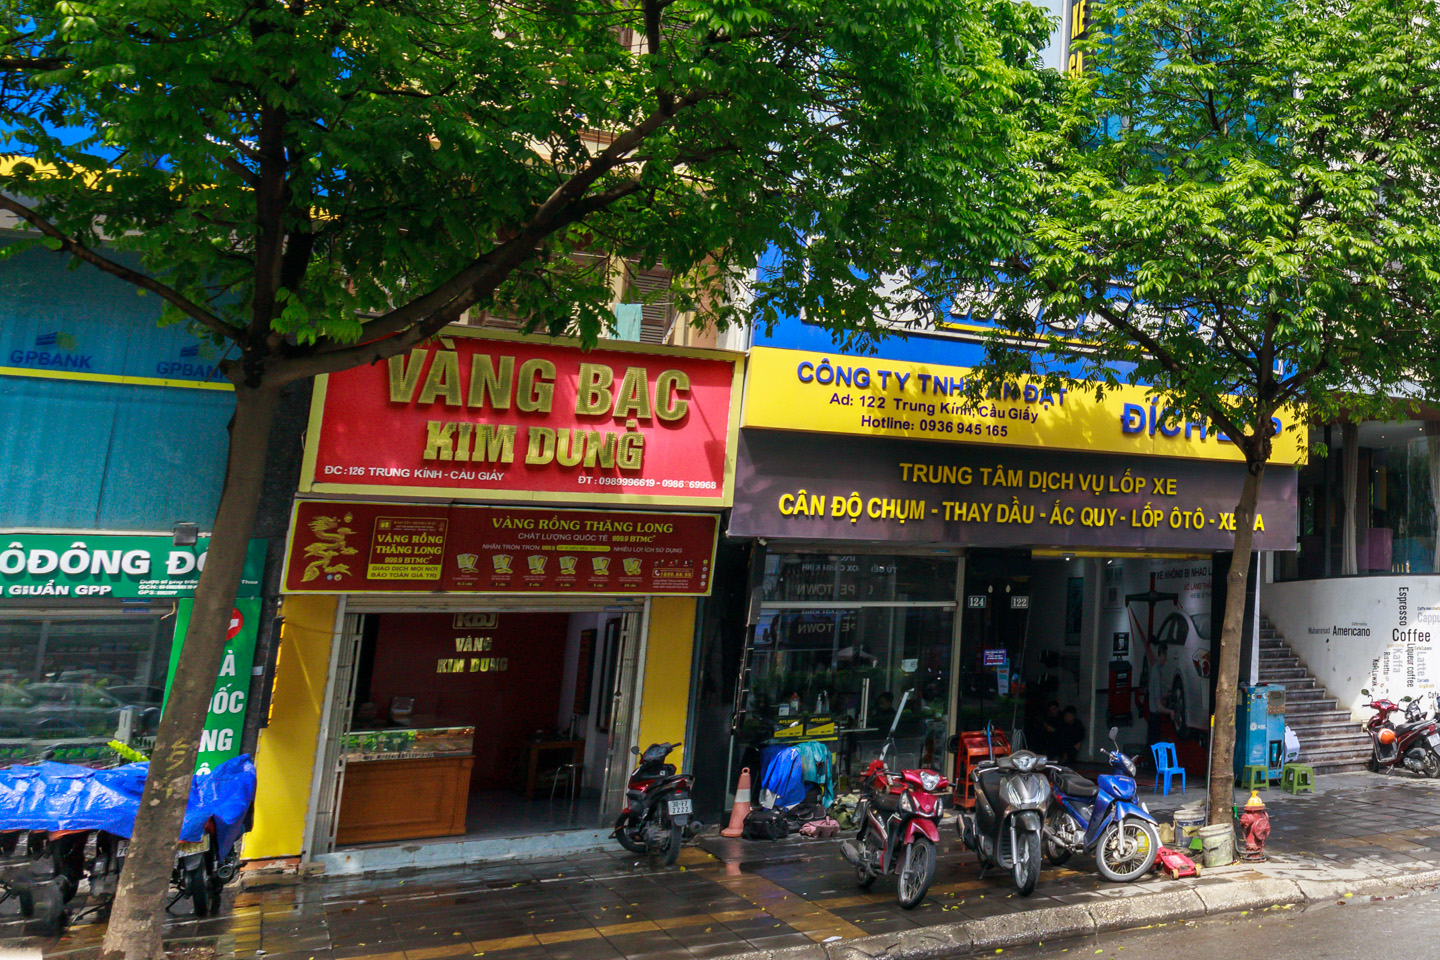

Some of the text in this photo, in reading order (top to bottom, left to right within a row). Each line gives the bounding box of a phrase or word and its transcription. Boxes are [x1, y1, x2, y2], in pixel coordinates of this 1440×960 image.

[10, 349, 93, 369] GPBANK
[388, 339, 691, 428] VÀNG BẠC
[797, 358, 871, 388] CÔNG
[878, 370, 911, 390] TY
[1023, 384, 1068, 410] ĐẠT
[829, 393, 854, 406] Ad:
[858, 395, 886, 409] 122
[894, 398, 936, 417] Trung
[979, 403, 1006, 420] Cầu
[860, 415, 1008, 437] Hotline: 0936 945 165
[423, 420, 645, 470] KIM DUNG
[349, 467, 365, 476] 126
[369, 467, 411, 478] TRUNG
[414, 465, 443, 479] KÍNH
[599, 476, 717, 489] 0989996619 098669968
[899, 462, 1178, 496] TRUNG TÂM DỊCH VỤ LỐP XE
[778, 489, 826, 516] CÂN
[831, 491, 863, 523] ĐỘ
[867, 497, 926, 524] CHỤM
[942, 501, 993, 522] THAY
[996, 496, 1035, 524] DẦU
[1049, 499, 1075, 526] ẮC
[1080, 507, 1118, 528] QUY
[1131, 501, 1164, 528] LỐP
[1169, 506, 1205, 529] ÔTÔ
[1218, 512, 1237, 531] XE
[492, 515, 673, 533] VÀNG RỒNG THĂNG LONG
[414, 546, 442, 554] LONG
[74, 585, 112, 595] GPP
[969, 597, 1027, 607] 124 122
[1397, 586, 1409, 626] Espresso
[1333, 625, 1371, 637] Americano
[1392, 628, 1431, 642] Coffee
[455, 635, 493, 652] VÀNG
[436, 657, 508, 674] KIM DUNG
[1393, 648, 1403, 673] Kaffa
[1417, 651, 1427, 676] Latte
[1406, 666, 1415, 688] coffee
